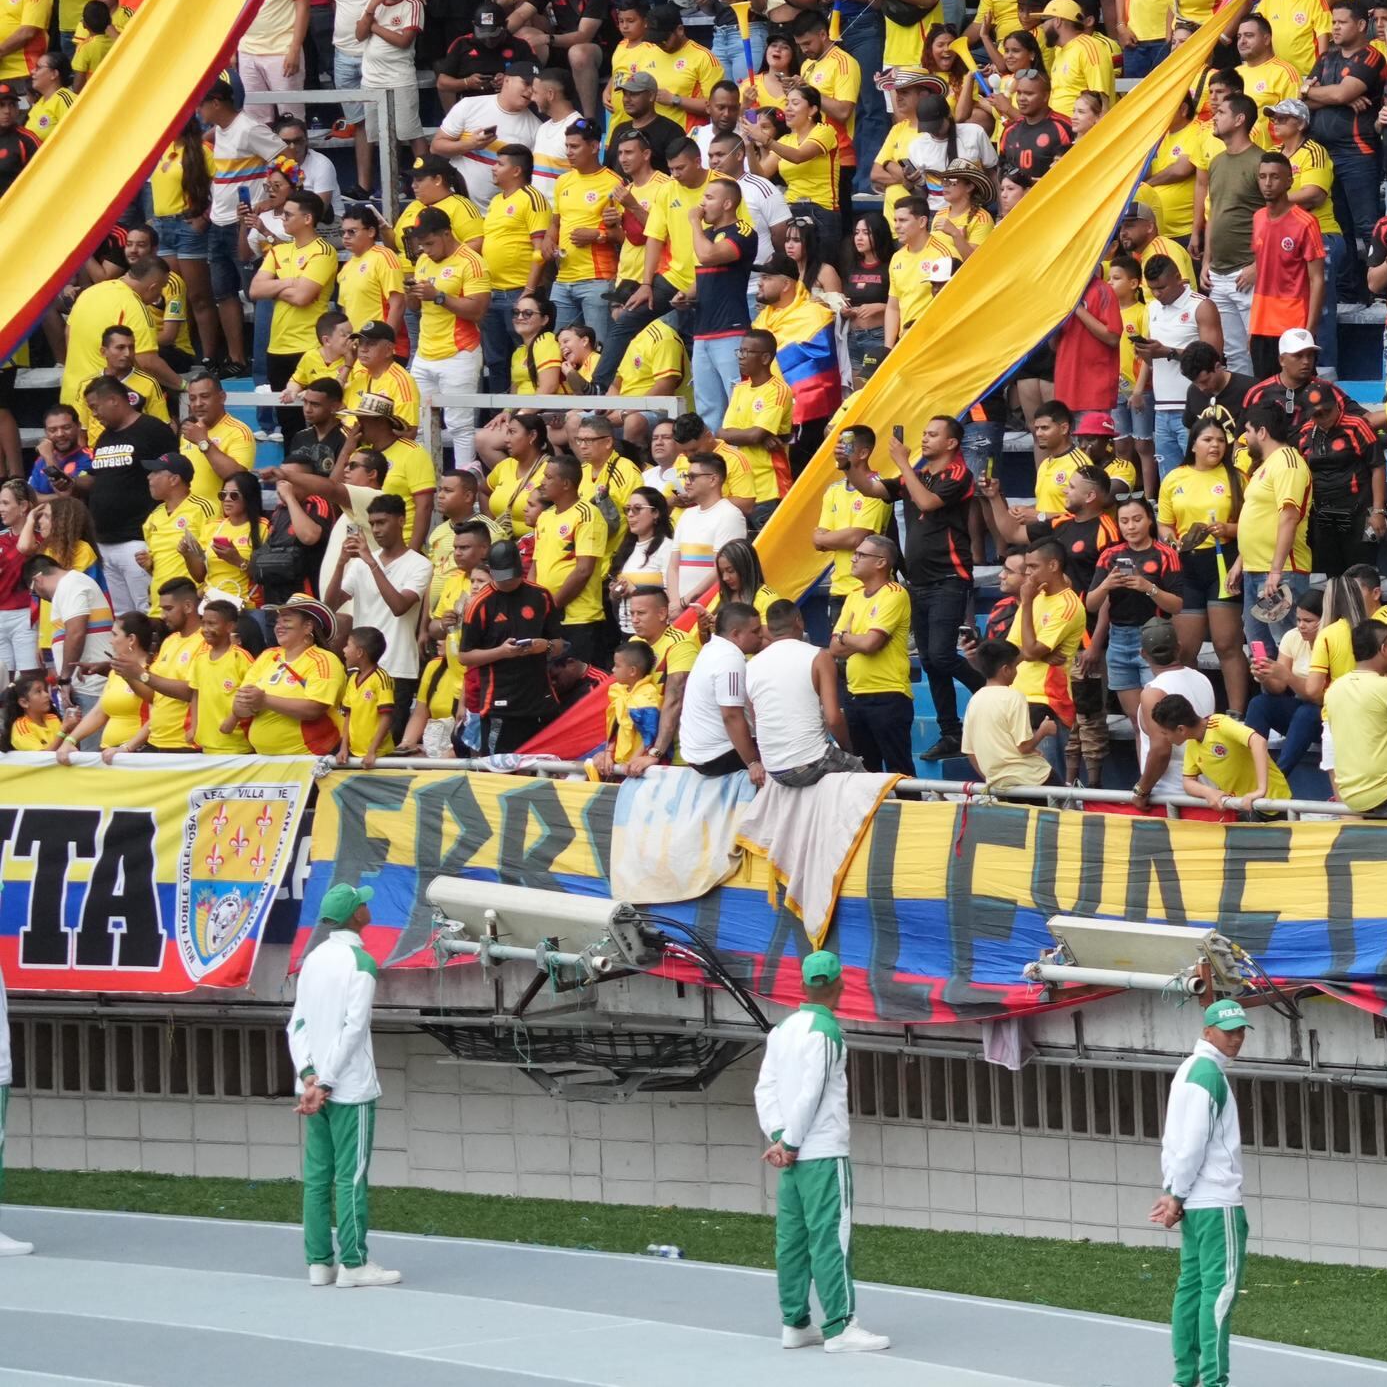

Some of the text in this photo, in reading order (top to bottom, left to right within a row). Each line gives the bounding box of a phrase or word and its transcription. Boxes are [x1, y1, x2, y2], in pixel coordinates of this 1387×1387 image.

[1020, 148, 1033, 169] 10
[238, 790, 265, 800] VILLA
[183, 813, 200, 883] VALEROSA
[181, 888, 193, 934] NOBLE
